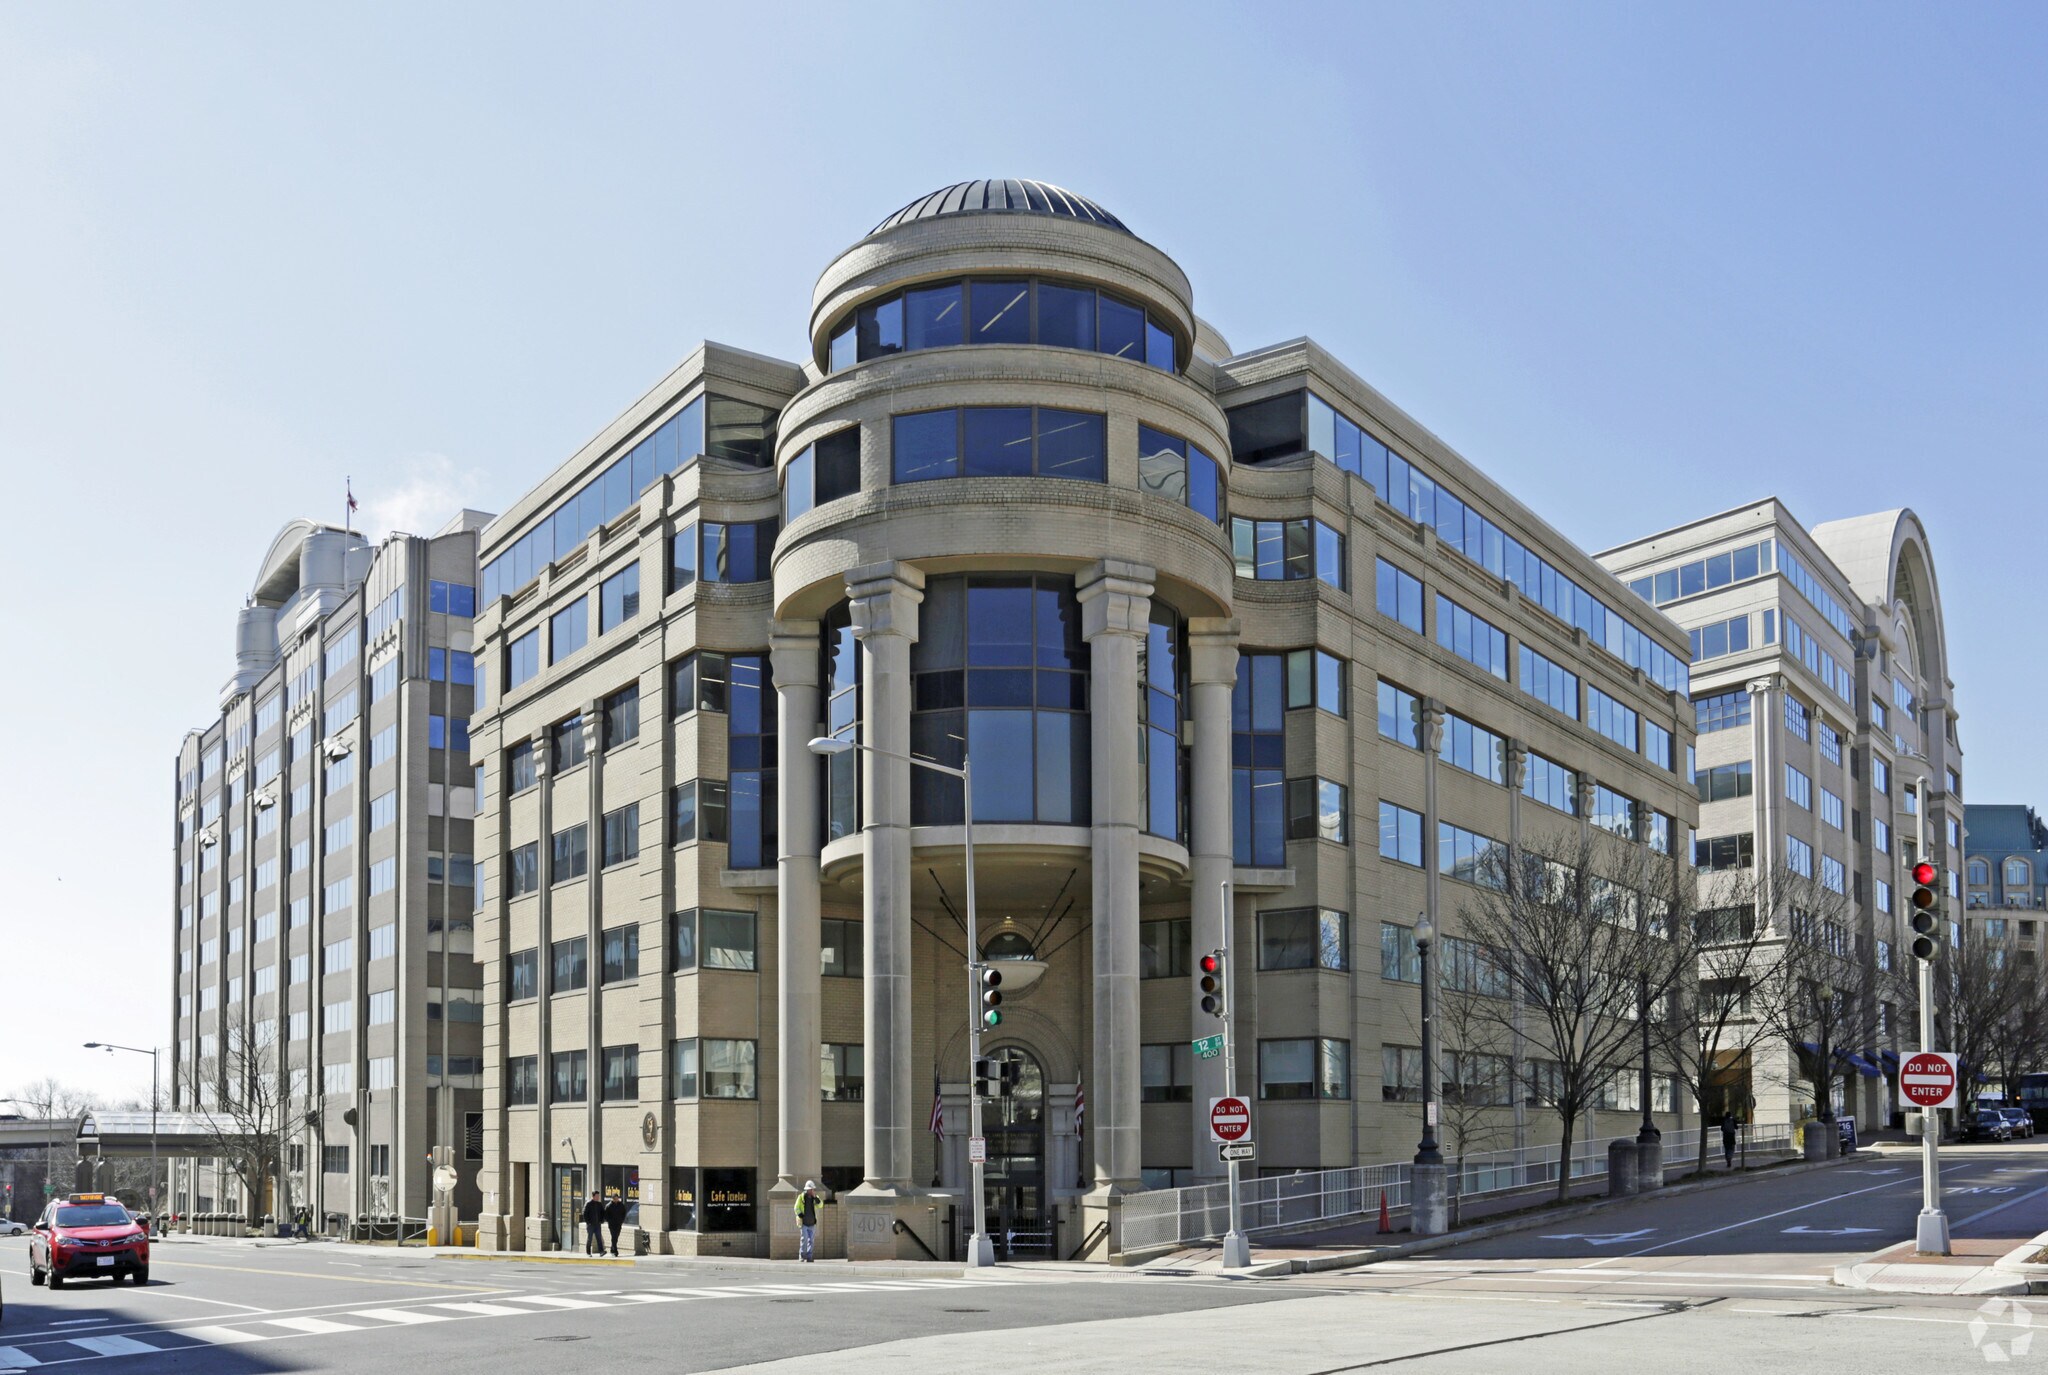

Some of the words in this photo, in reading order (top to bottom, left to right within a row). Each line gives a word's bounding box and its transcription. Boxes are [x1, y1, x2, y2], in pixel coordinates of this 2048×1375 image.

[1198, 1040, 1209, 1051] 12
[1202, 1049, 1218, 1058] 400
[1908, 1063, 1922, 1072] DO
[1927, 1064, 1947, 1072] NOT
[1911, 1087, 1943, 1096] ENTER
[711, 1190, 725, 1201] Cafe
[727, 1190, 747, 1201] Twelve
[858, 1216, 885, 1232] 409
